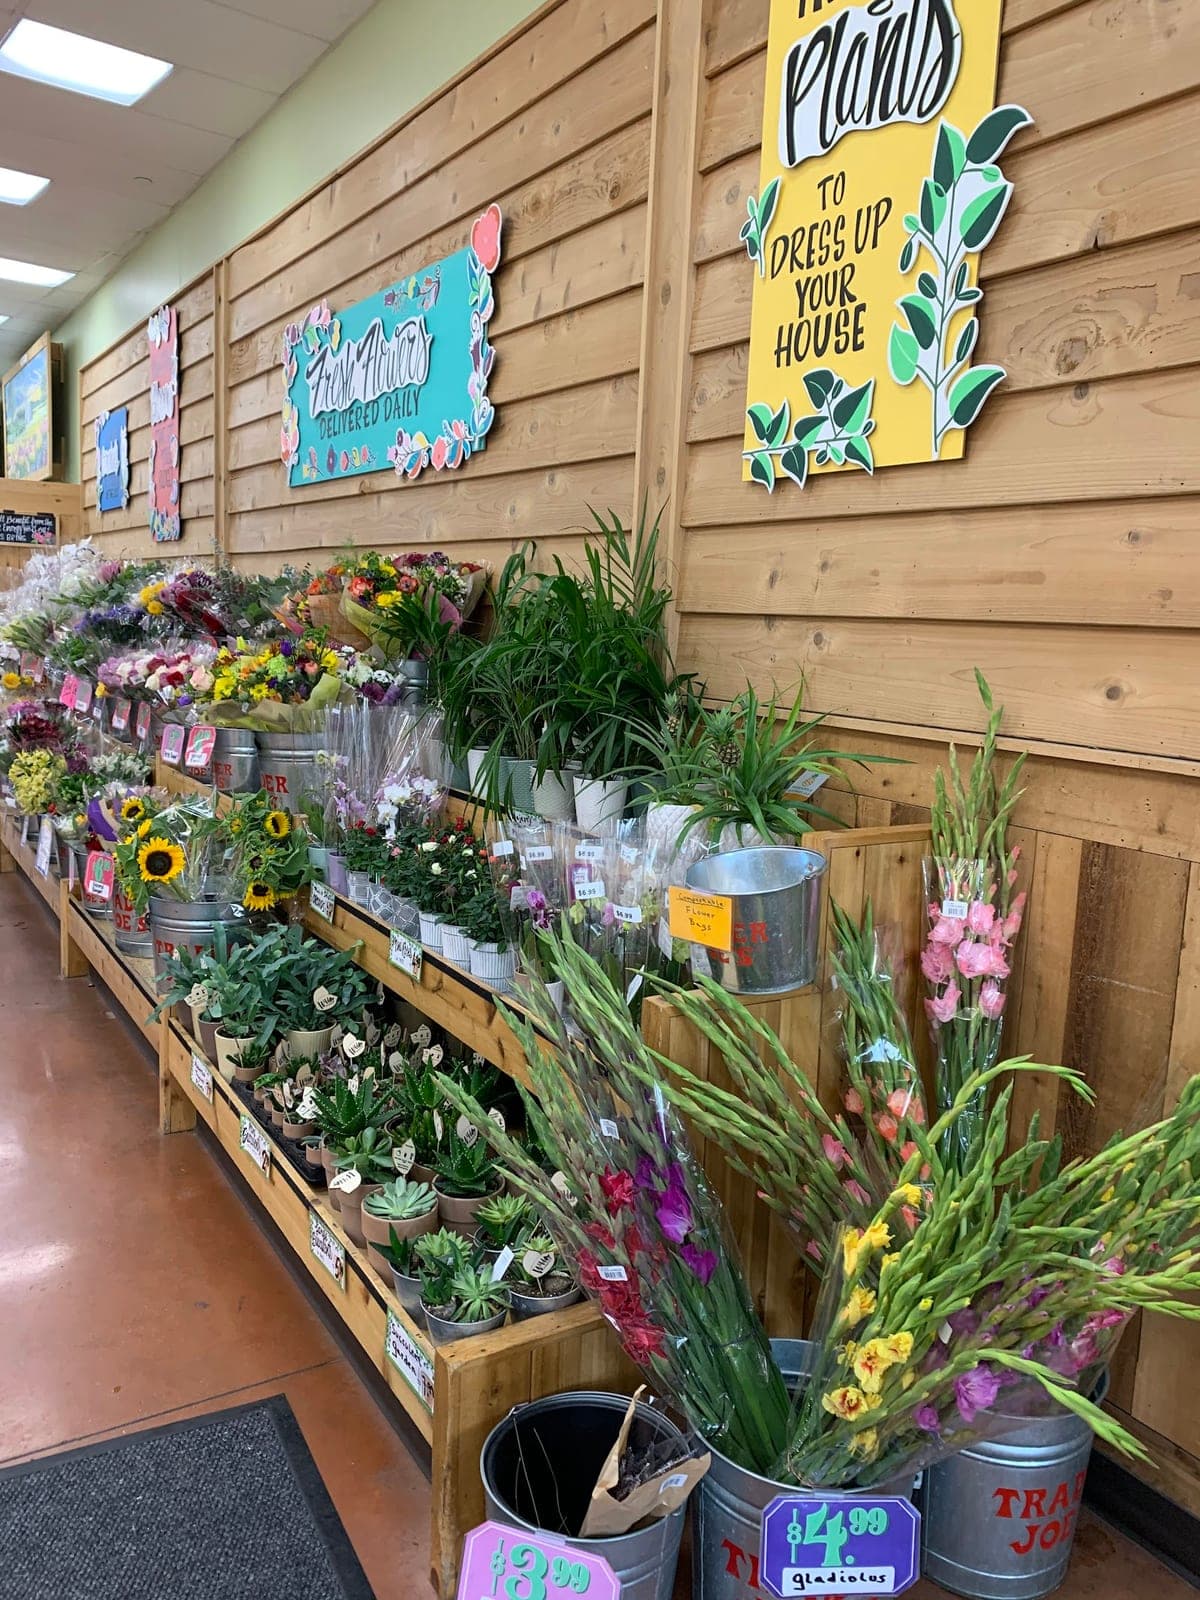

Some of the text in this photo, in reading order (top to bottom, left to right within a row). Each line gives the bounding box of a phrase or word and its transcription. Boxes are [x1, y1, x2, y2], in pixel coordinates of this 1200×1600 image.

[817, 171, 846, 210] TO
[770, 197, 893, 280] DRESS UP
[795, 262, 857, 319] YOUR
[774, 303, 867, 368] HOUSE
[306, 317, 430, 417] Fresh Flowers
[319, 389, 422, 440] DELIVERED DAILY
[786, 1502, 889, 1567] $4.99
[791, 1569, 888, 1592] gladiolus
